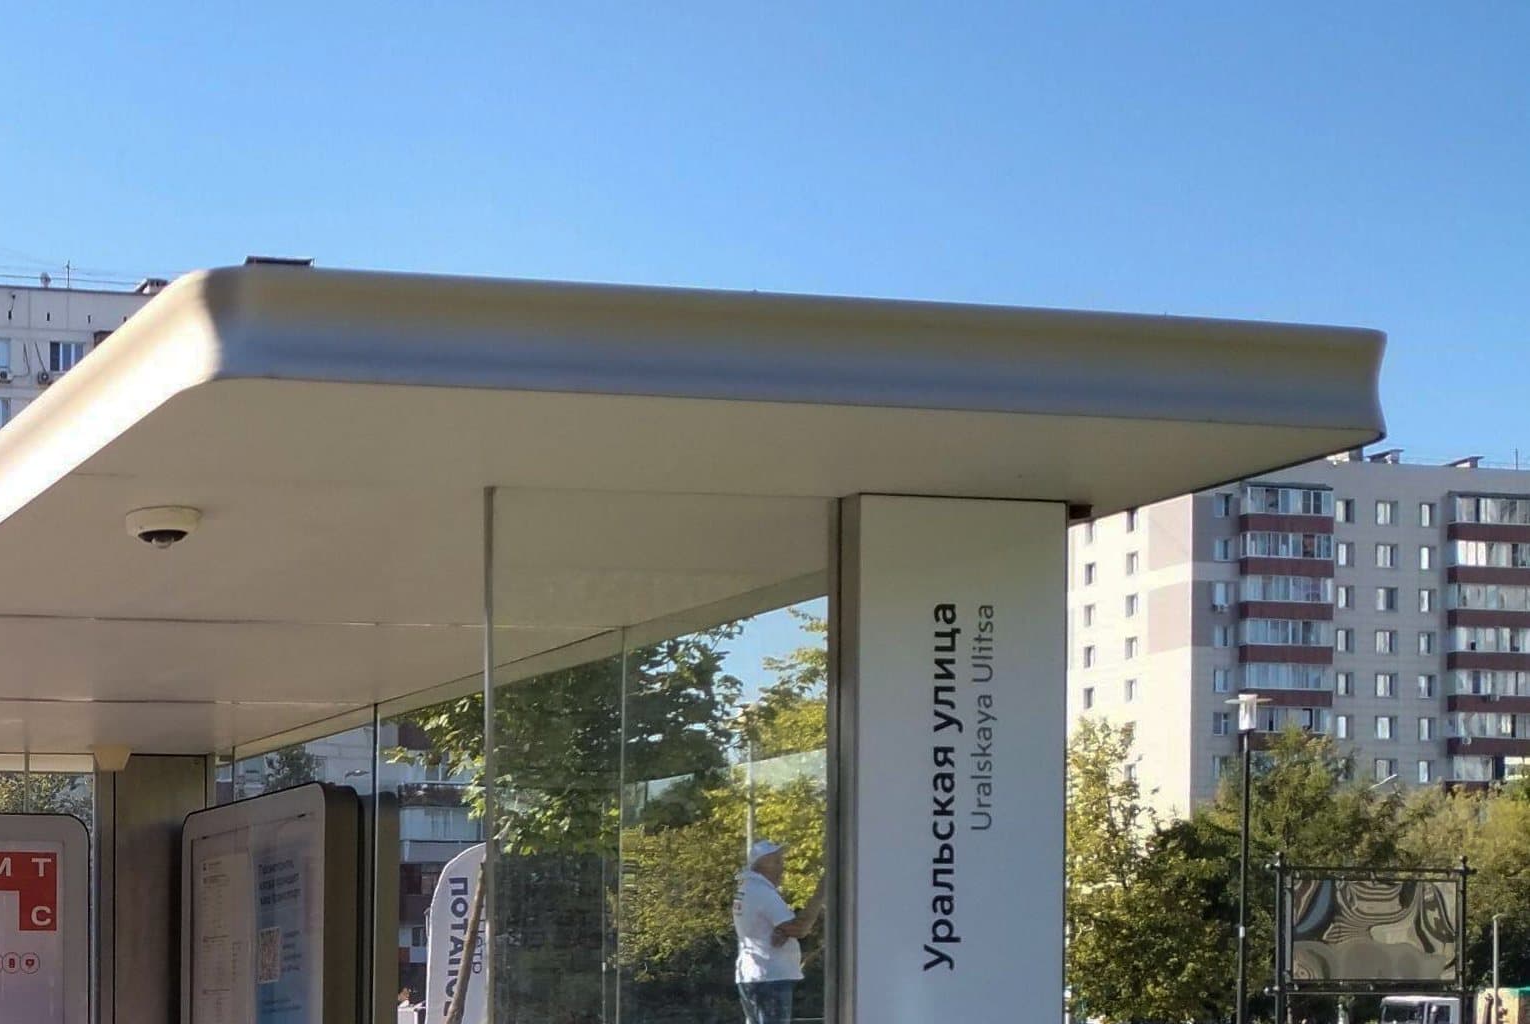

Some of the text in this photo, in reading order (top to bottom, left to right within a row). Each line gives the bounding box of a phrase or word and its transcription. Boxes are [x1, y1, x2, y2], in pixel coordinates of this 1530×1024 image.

[923, 602, 963, 971] Уральская улица
[971, 603, 998, 831] Uralskaya Ulitsa
